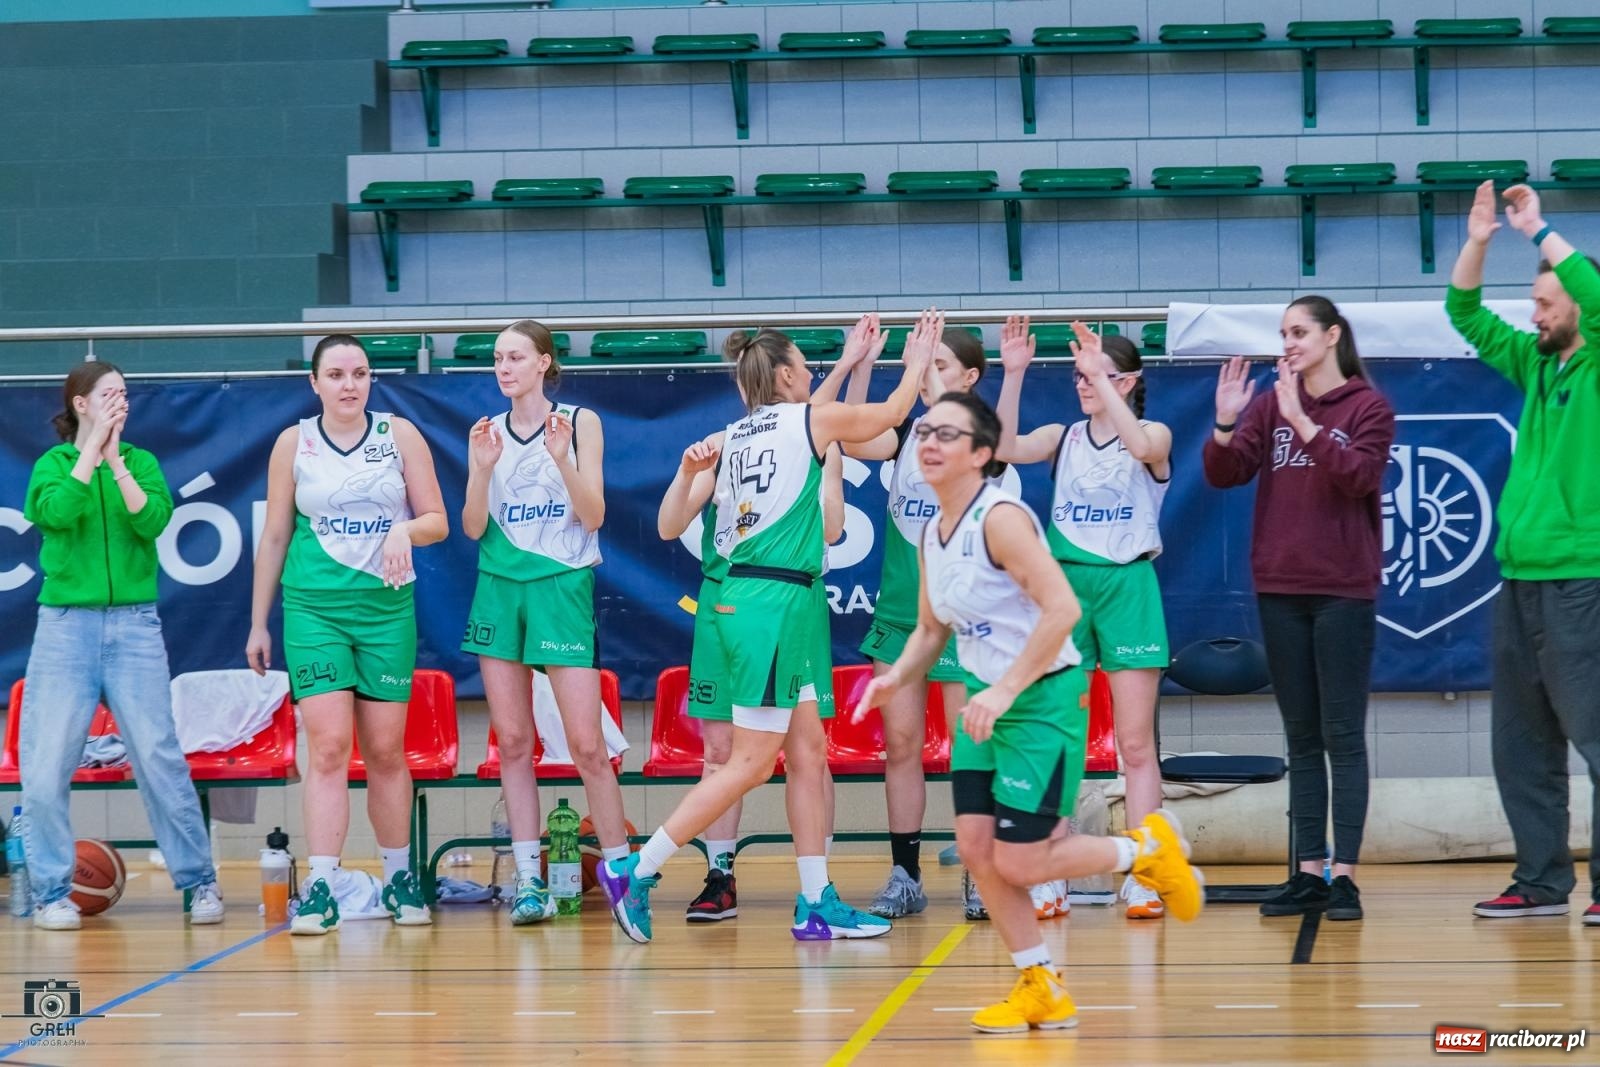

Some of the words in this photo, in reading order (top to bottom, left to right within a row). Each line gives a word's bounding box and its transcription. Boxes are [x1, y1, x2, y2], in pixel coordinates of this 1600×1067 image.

[364, 442, 399, 463] 24
[730, 446, 777, 501] 14
[507, 499, 566, 523] Clavis
[904, 499, 941, 518] Cla
[1072, 503, 1134, 523] Clavis
[329, 515, 392, 535] Clavis
[296, 661, 338, 689] 24
